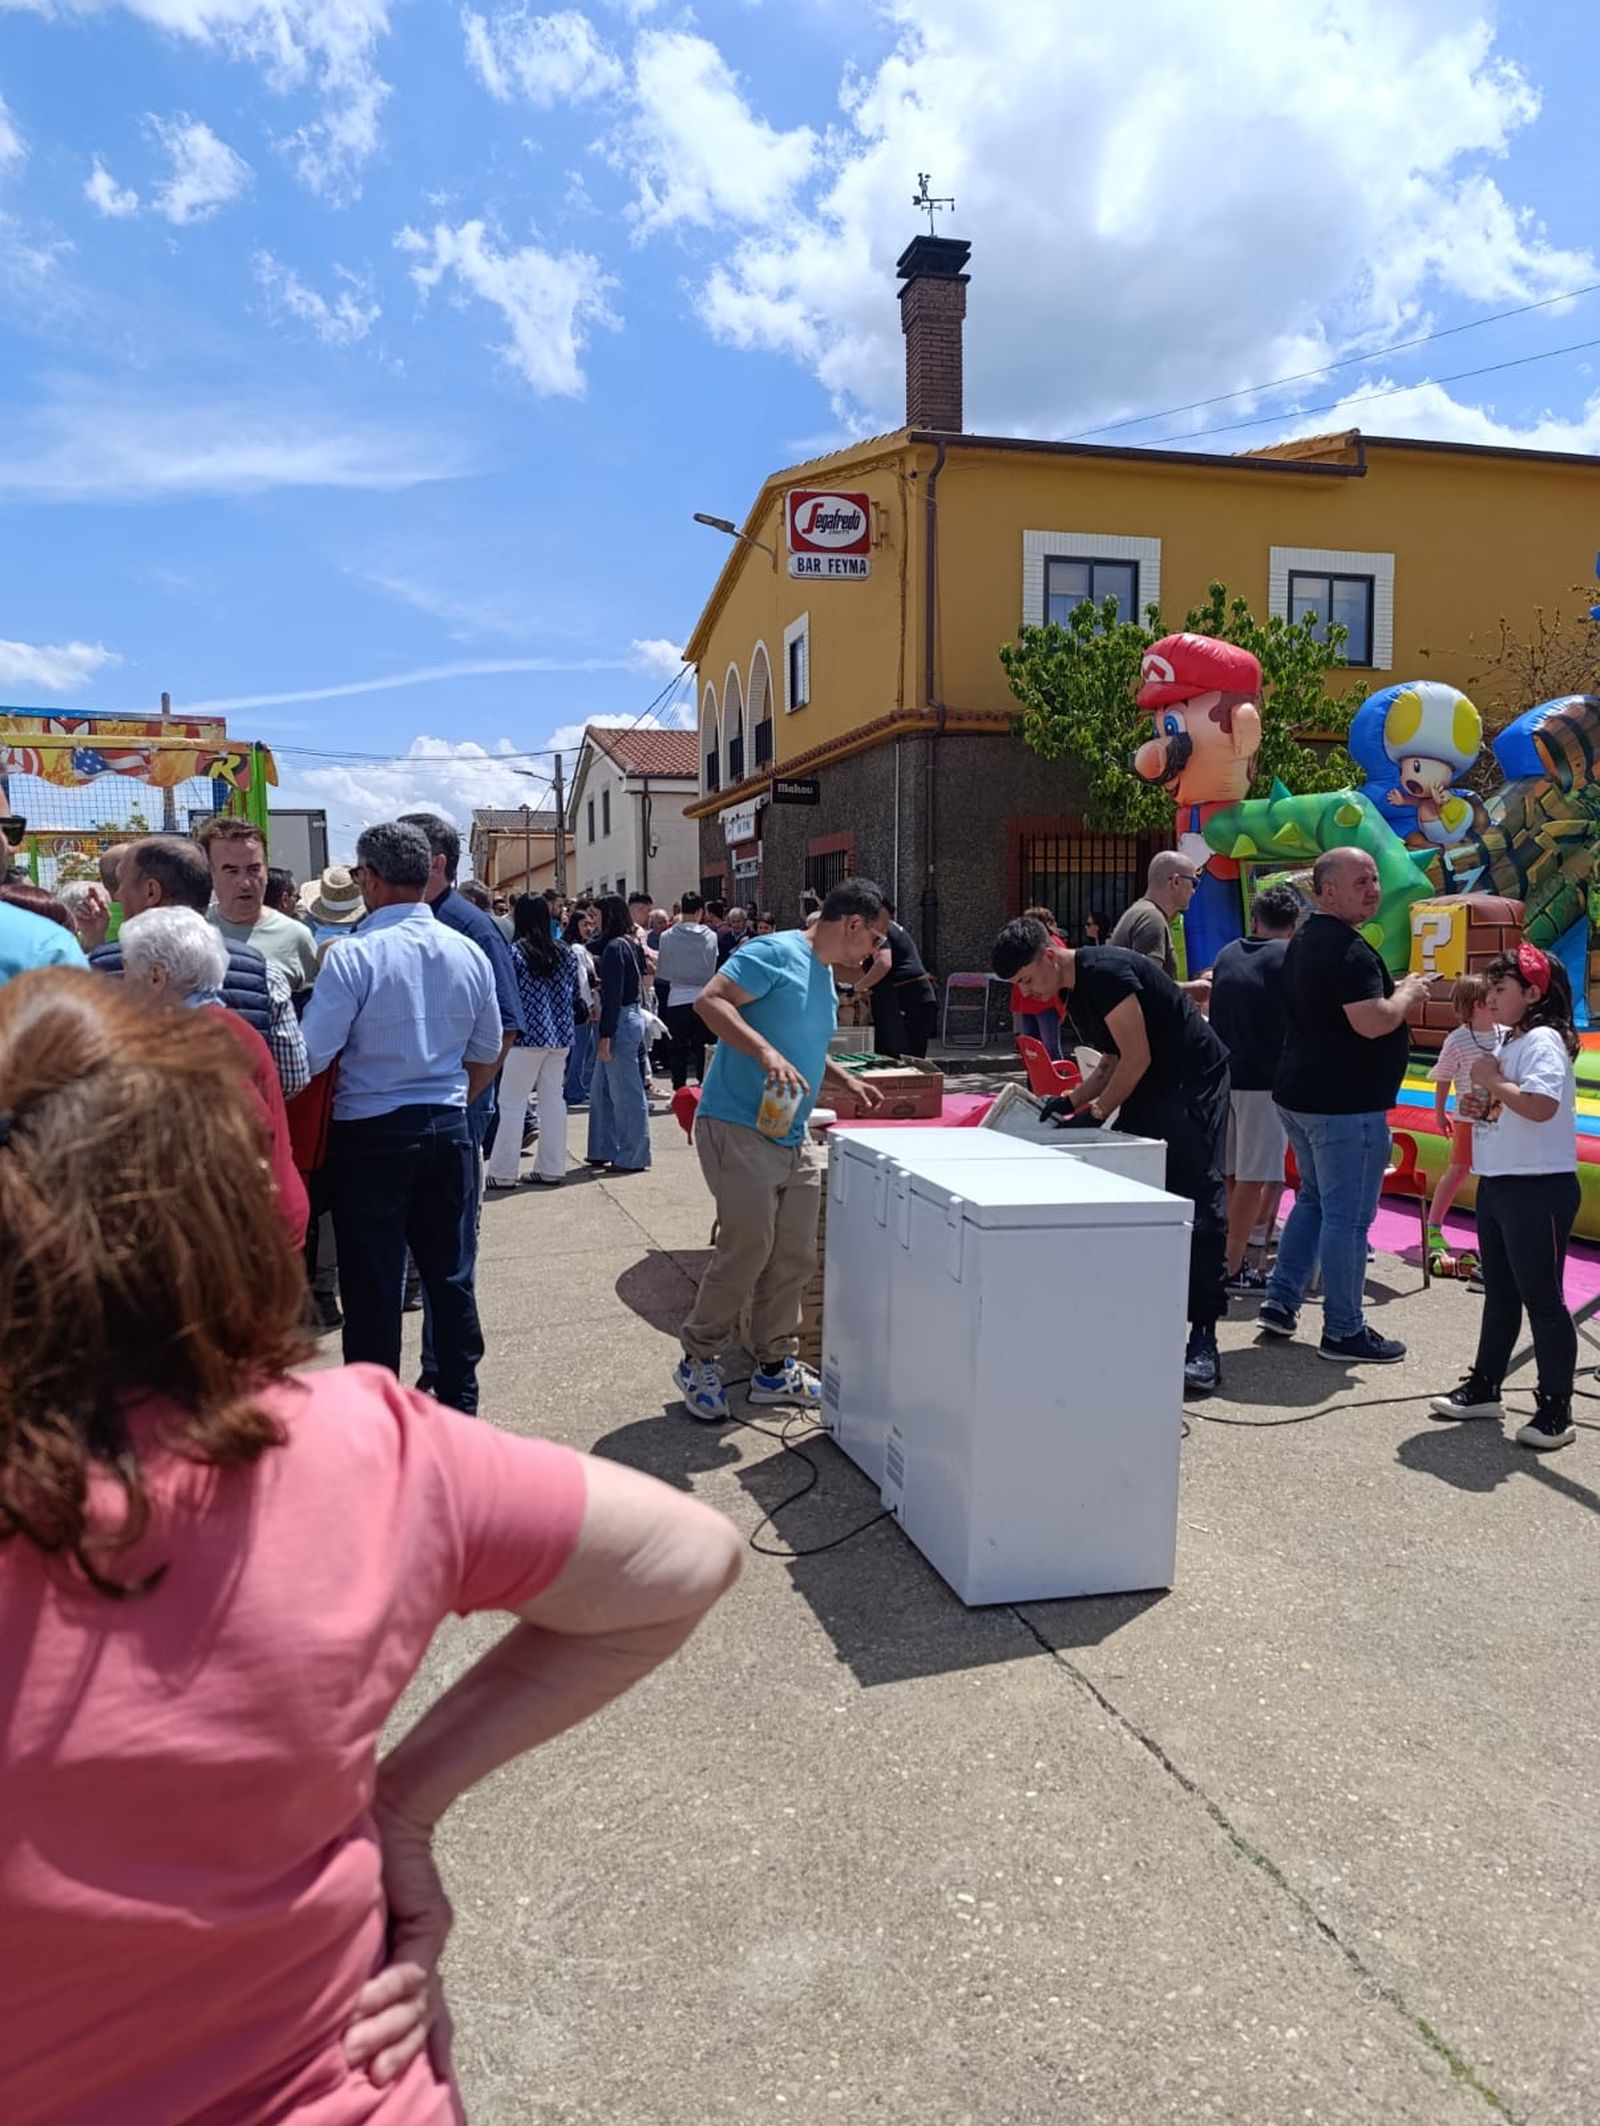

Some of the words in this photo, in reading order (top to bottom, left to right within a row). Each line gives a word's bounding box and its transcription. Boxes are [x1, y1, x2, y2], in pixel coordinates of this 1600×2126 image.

[801, 502, 861, 534] Segafredo
[797, 557, 821, 573] BAR
[828, 558, 867, 575] FEYMA
[777, 783, 814, 795] Mahou
